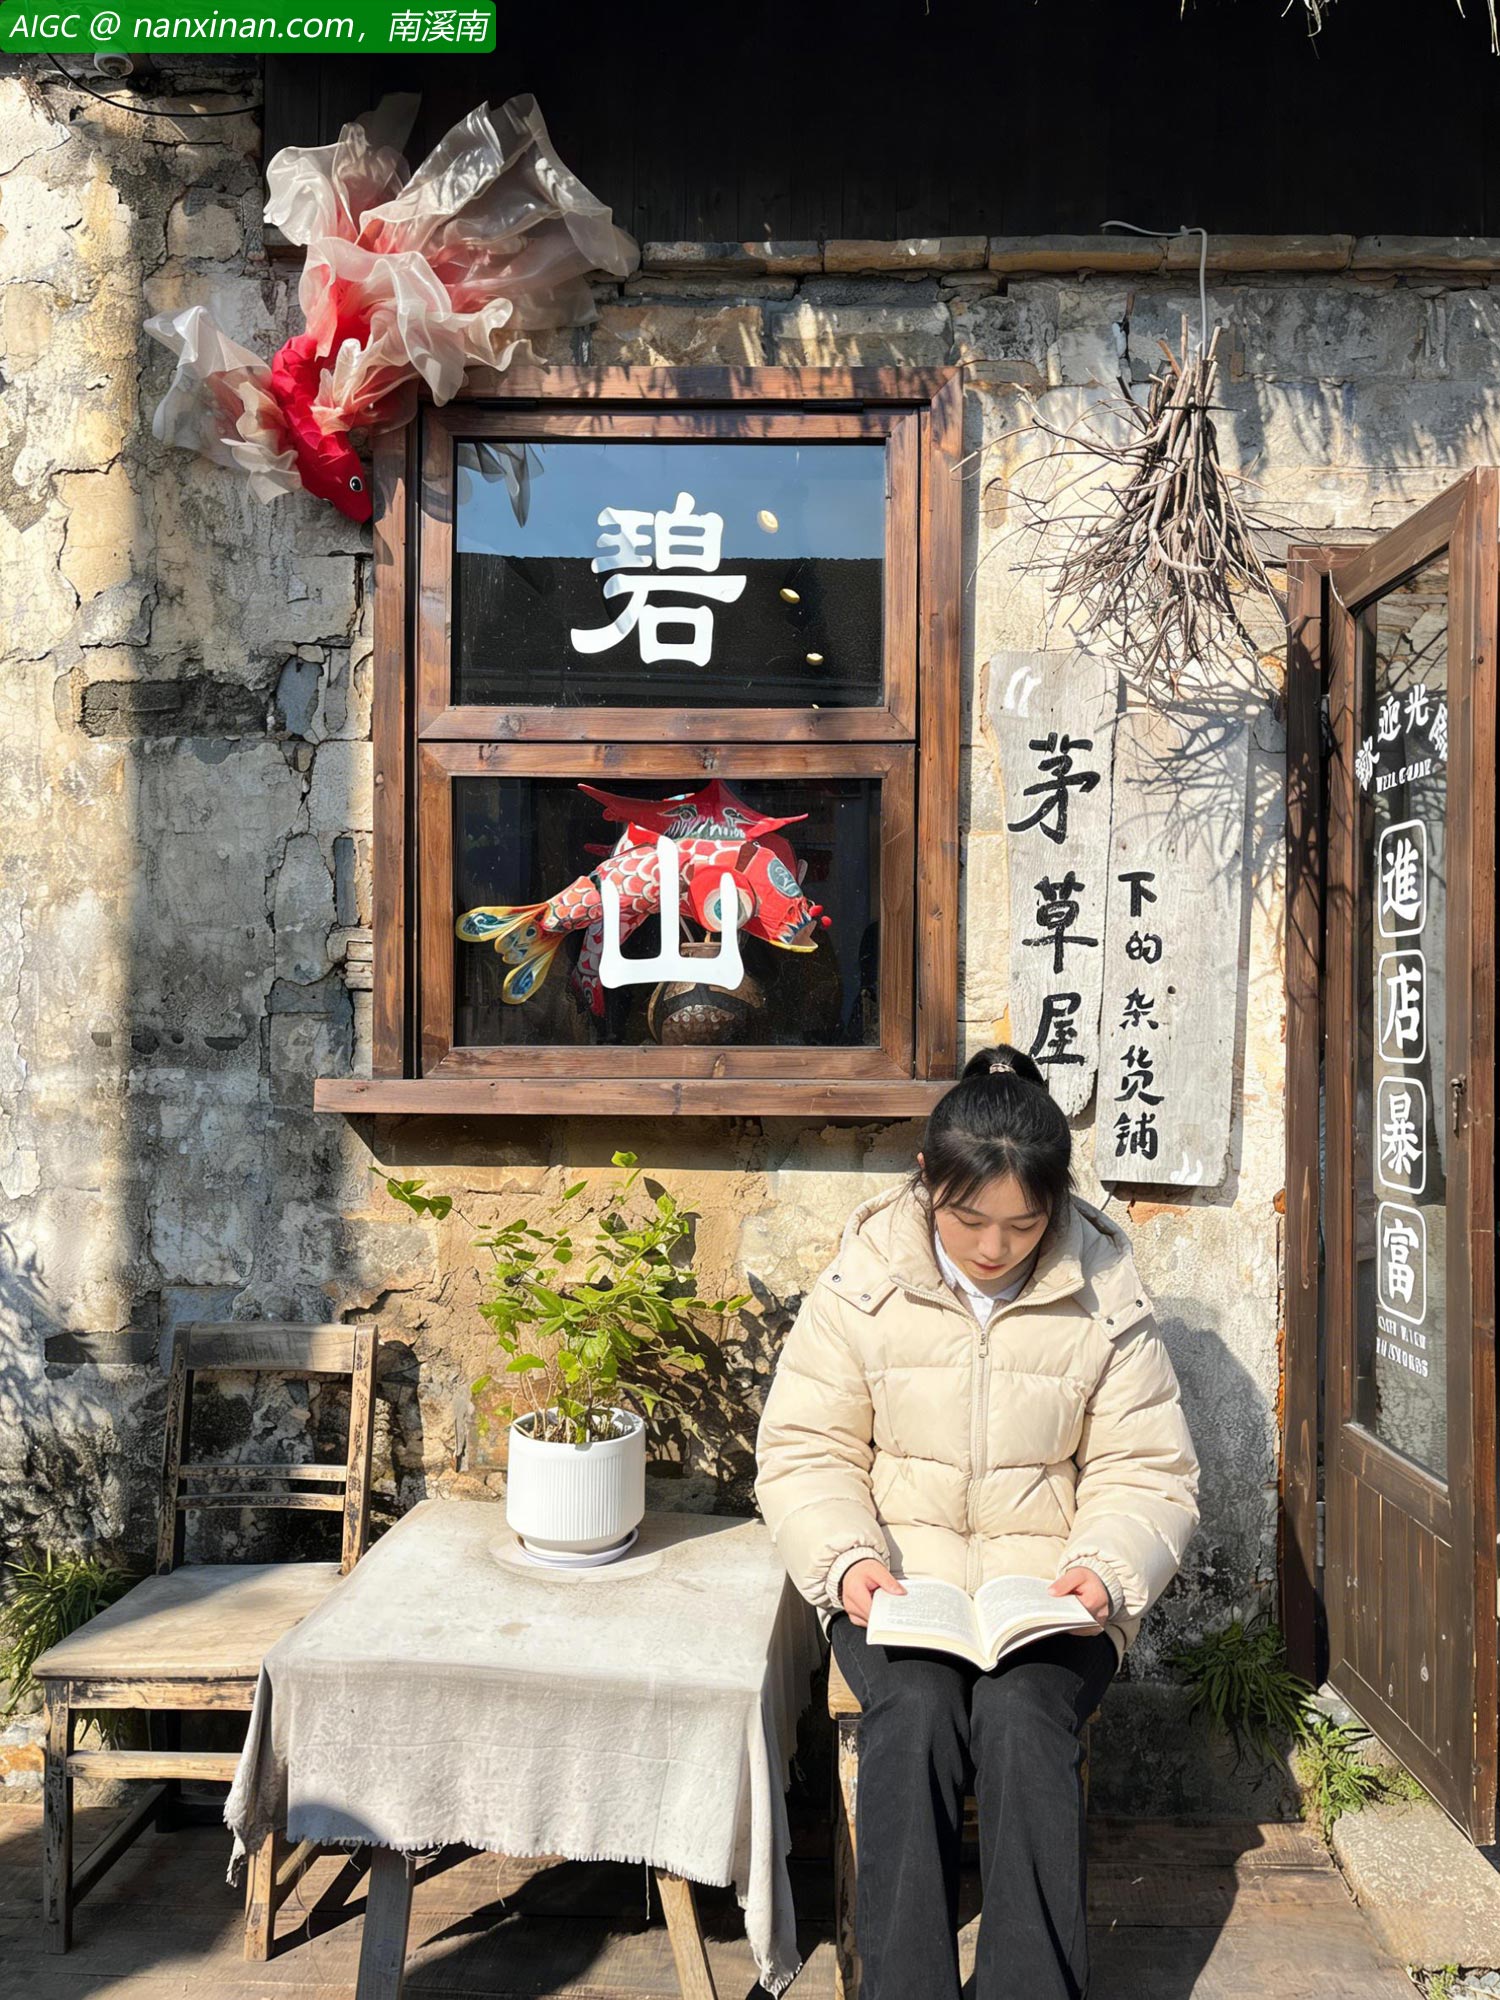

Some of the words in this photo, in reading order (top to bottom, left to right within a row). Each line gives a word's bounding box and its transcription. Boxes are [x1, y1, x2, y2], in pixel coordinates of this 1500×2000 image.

[1114, 871, 1166, 1161] 下的杂货铺
